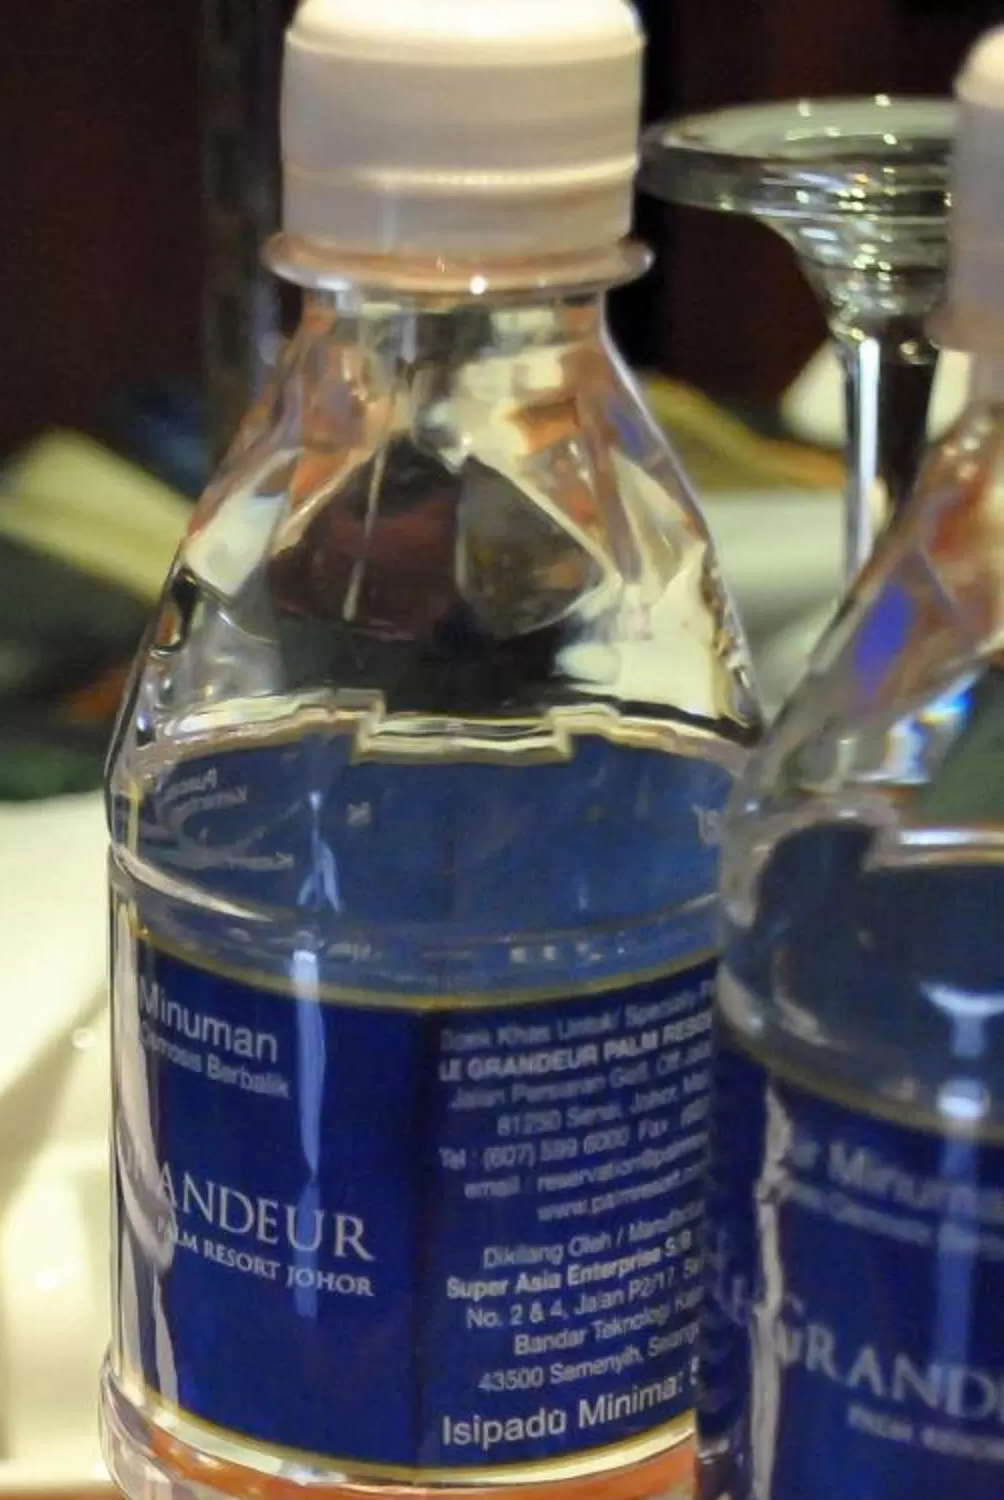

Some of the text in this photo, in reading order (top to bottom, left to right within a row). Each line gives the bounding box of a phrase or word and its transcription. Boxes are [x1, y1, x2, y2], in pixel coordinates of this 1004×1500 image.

[159, 1160, 376, 1261] ANDEUR
[203, 1238, 281, 1280] RESORT
[286, 1264, 375, 1297] JOHOR
[447, 1275, 509, 1302] Super
[515, 1269, 562, 1294] Asia
[514, 1326, 588, 1356] Bandar
[478, 1366, 544, 1393] 43500
[442, 1407, 567, 1451] Isipadu
